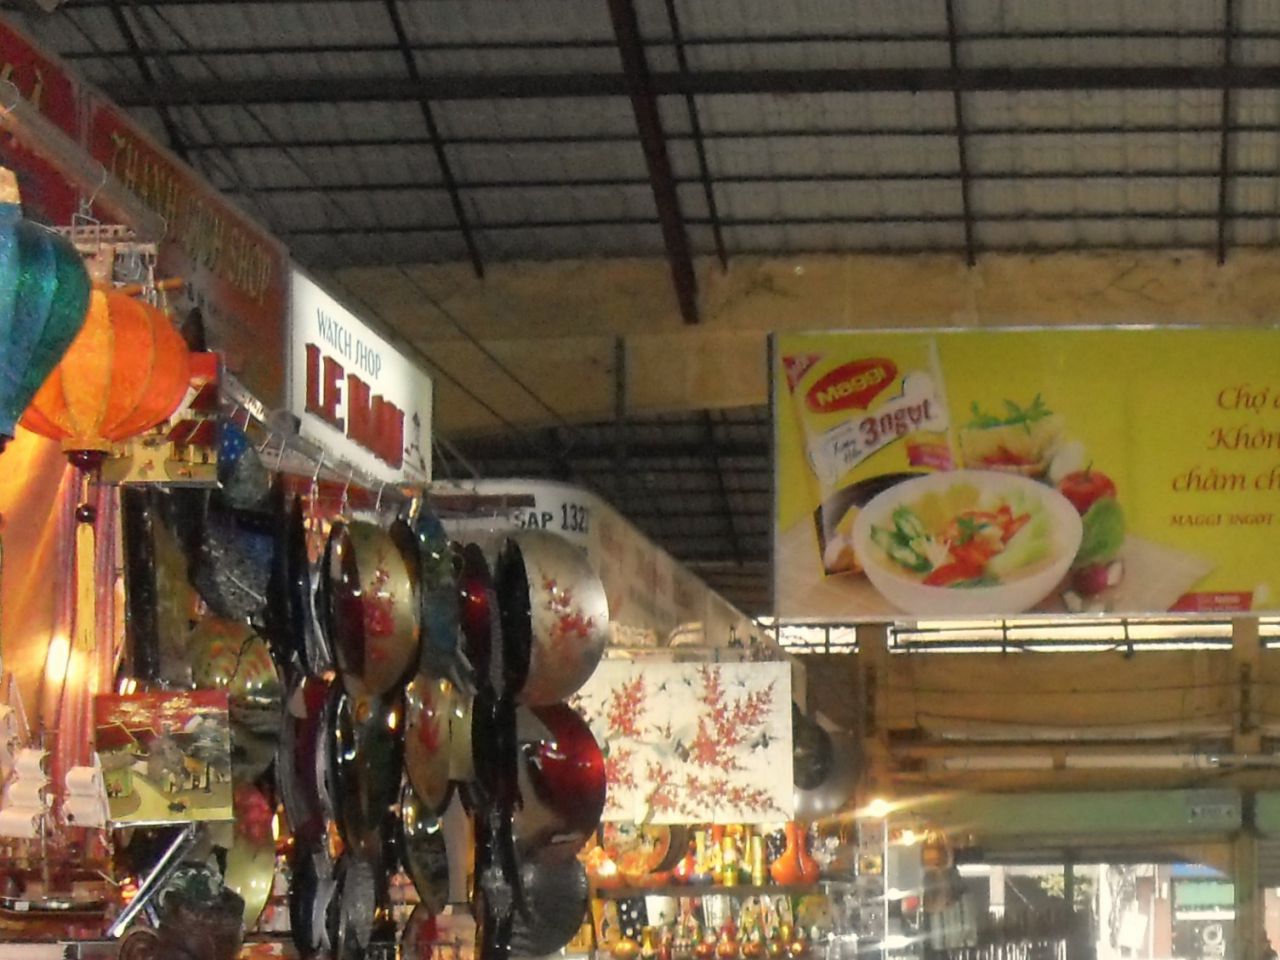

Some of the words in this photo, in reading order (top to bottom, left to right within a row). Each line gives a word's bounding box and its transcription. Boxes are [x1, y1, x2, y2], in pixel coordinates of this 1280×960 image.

[316, 306, 353, 361] WATCH
[354, 338, 383, 381] SHOP
[815, 366, 888, 407] Maggi
[1169, 512, 1223, 527] MAGGI
